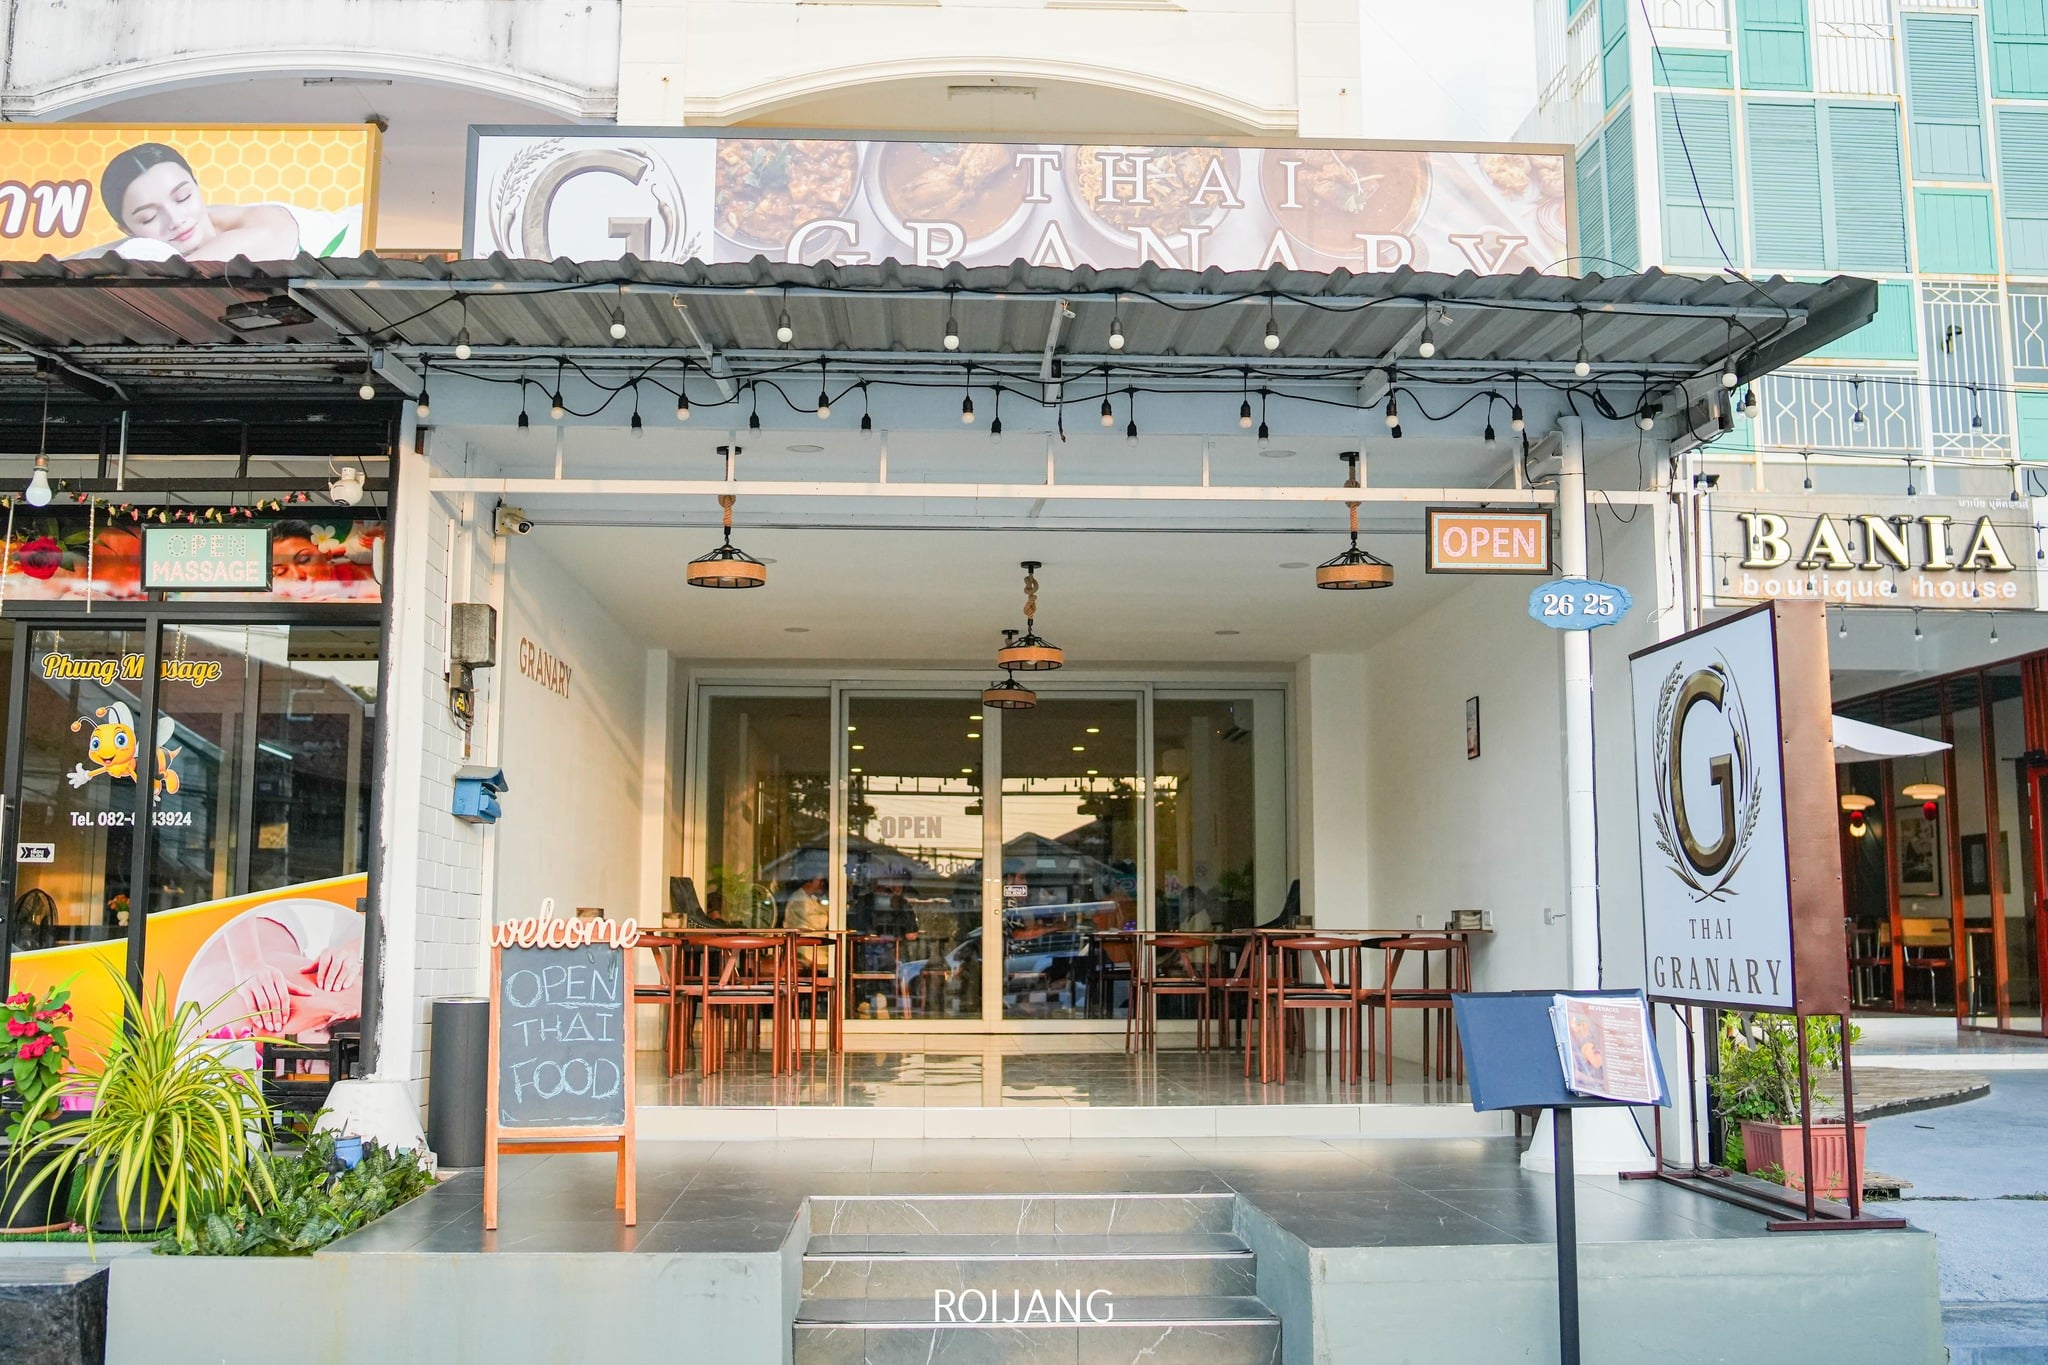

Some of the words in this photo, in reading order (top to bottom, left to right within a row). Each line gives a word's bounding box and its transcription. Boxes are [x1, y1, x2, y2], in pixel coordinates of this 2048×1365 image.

[1015, 151, 1305, 210] THAI
[168, 534, 246, 557] OPEN
[1442, 526, 1535, 558] OPEN
[1738, 512, 2017, 571] BANIA
[152, 560, 260, 582] MASSAGE
[1742, 573, 1894, 600] boutique
[1918, 573, 2017, 599] house
[1543, 594, 1574, 616] 26
[1584, 593, 1614, 616] 25
[42, 652, 119, 687] Phung
[121, 653, 222, 688] Mssage
[520, 637, 571, 699] GRANARY
[1669, 668, 1737, 876] G
[70, 811, 95, 826] Tel.
[881, 816, 942, 838] OPEN
[488, 897, 641, 949] welcome
[1689, 918, 1733, 940] THAI
[505, 965, 620, 1009] OPEN
[1653, 955, 1782, 996] GRANARY
[512, 1012, 616, 1047] THAI
[509, 1057, 621, 1103] FOOD
